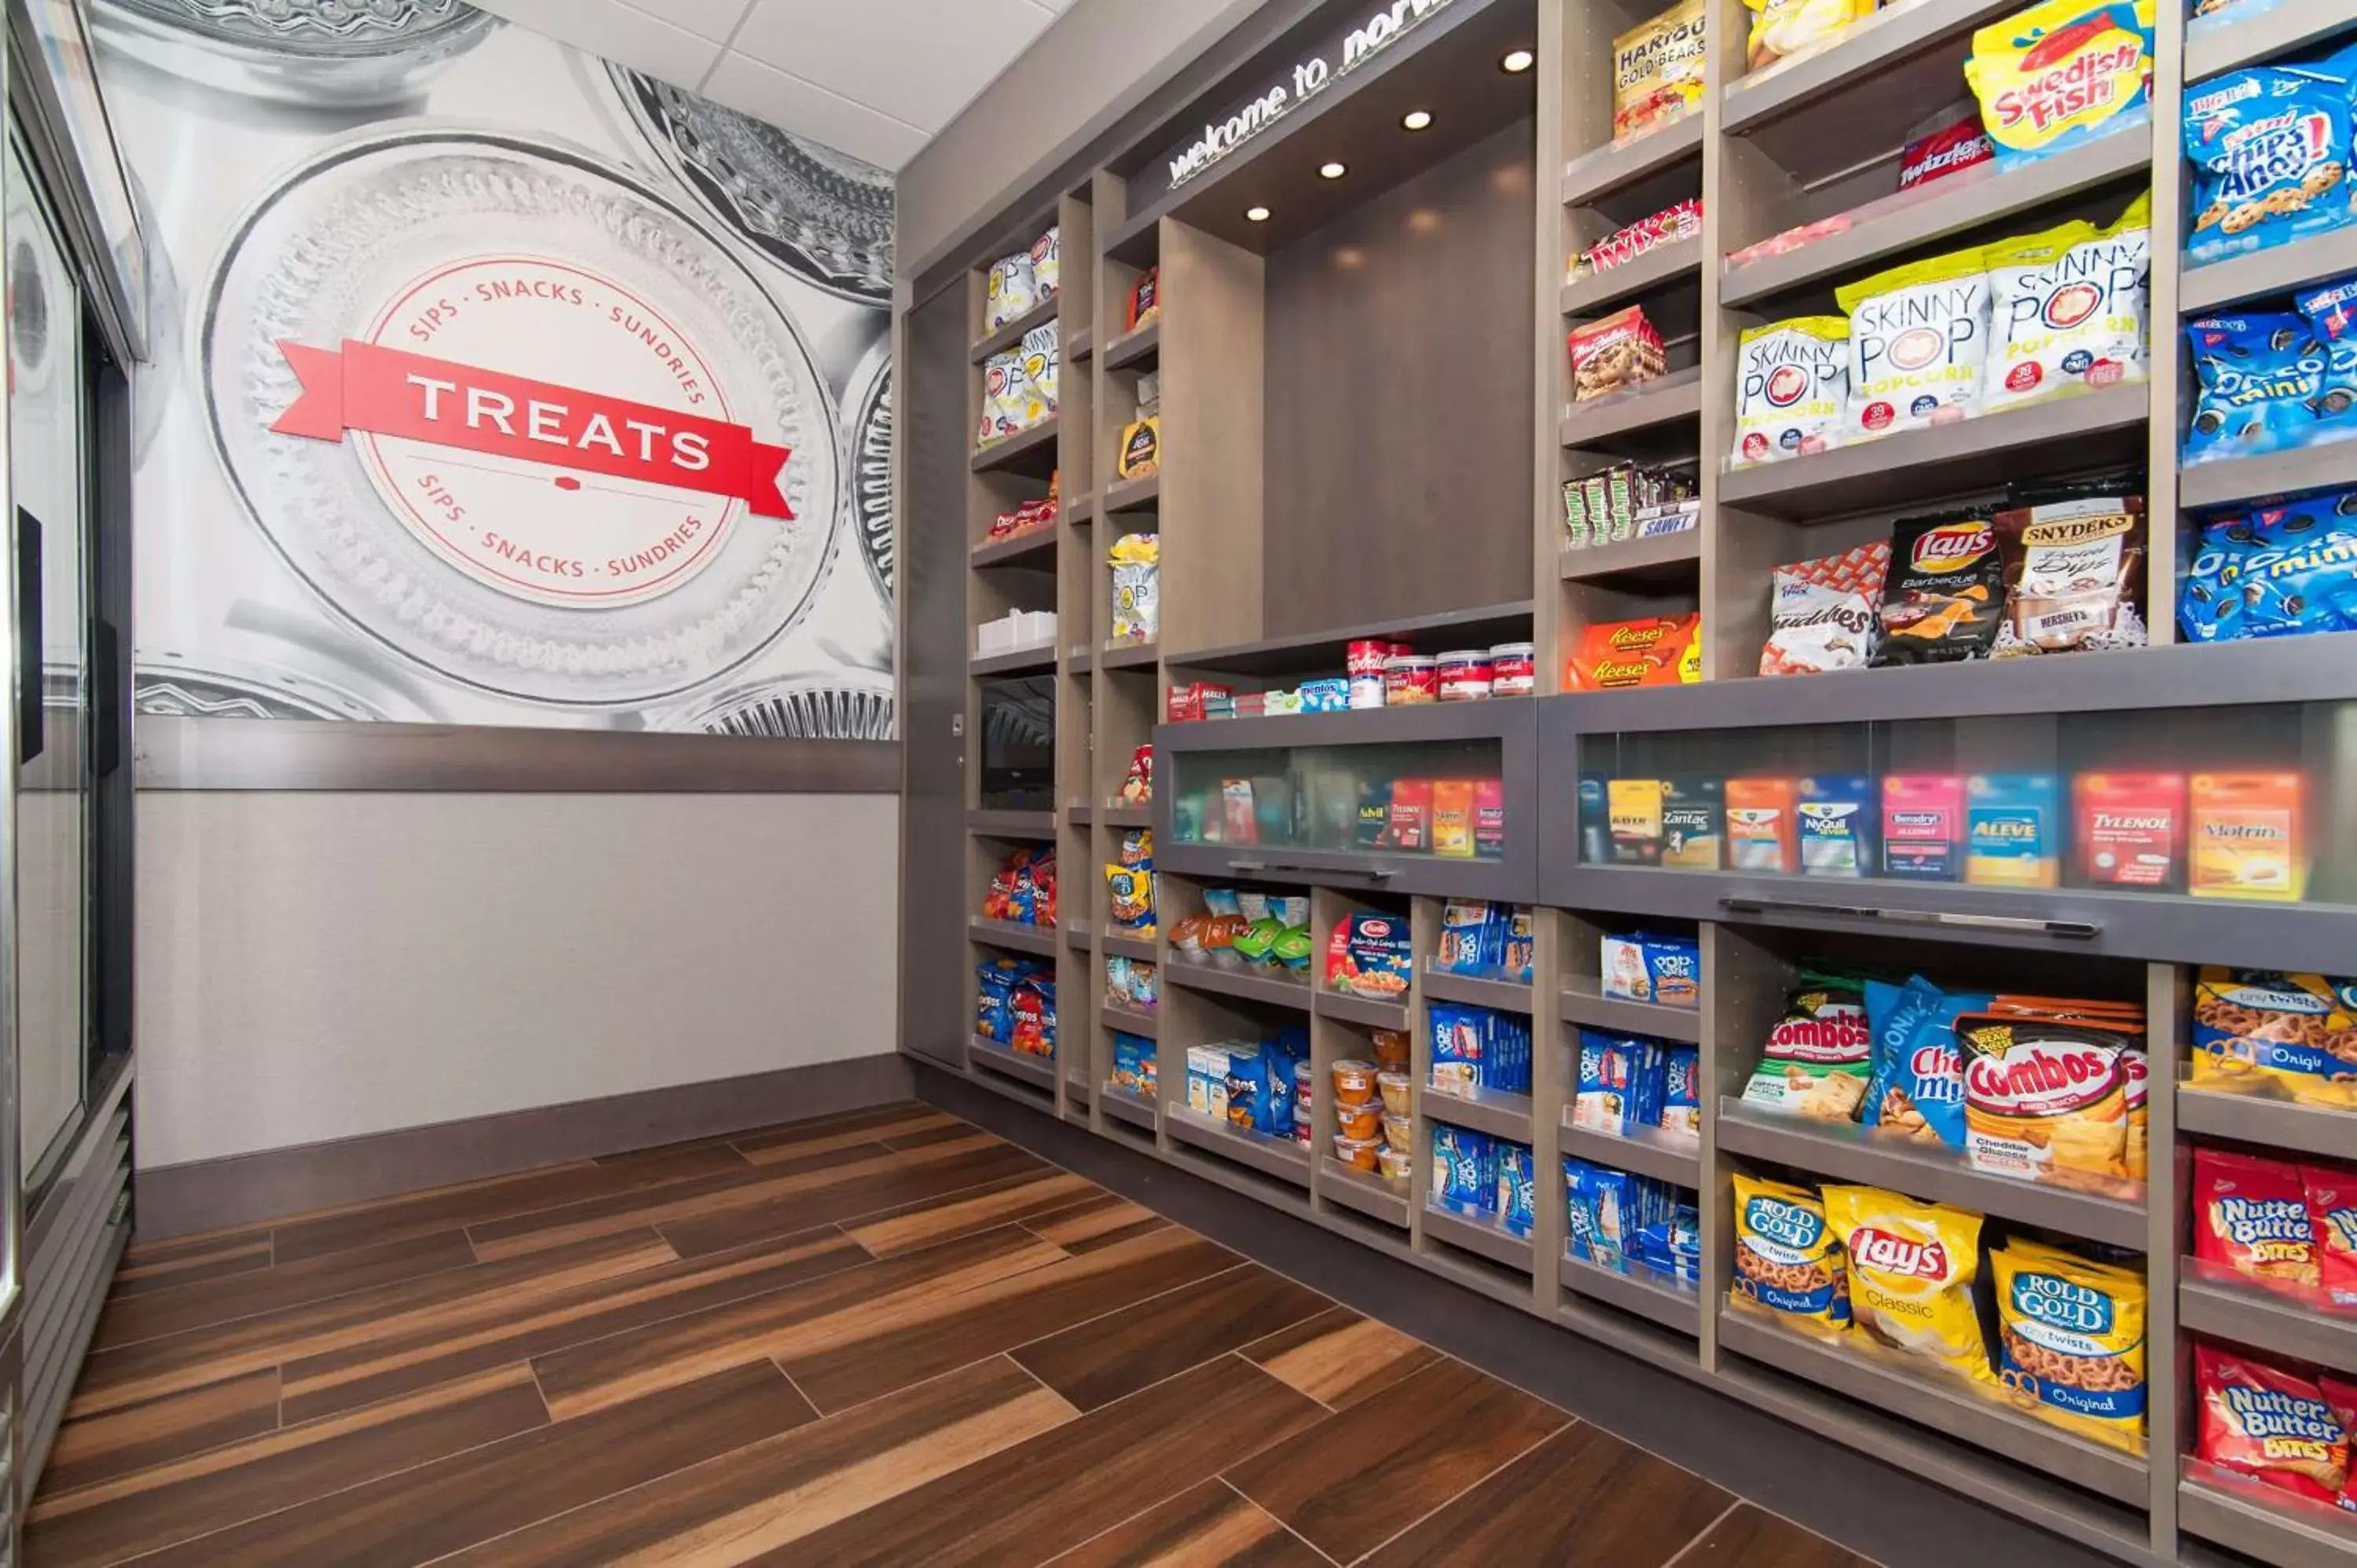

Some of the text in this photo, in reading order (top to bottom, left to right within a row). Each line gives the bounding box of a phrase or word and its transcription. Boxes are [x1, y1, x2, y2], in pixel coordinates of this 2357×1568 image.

[1995, 43, 2142, 127] Swedish
[1169, 86, 1288, 182] welcome
[1292, 57, 1329, 98] to
[2029, 79, 2115, 132] Fish
[1581, 214, 1671, 275] TWIX
[1860, 284, 1977, 336] SKINNY
[2008, 266, 2137, 343] POP
[409, 279, 705, 406] SIPS SNACKS SUNDRIES
[1746, 338, 1835, 374] SKINNY
[1860, 317, 1974, 383] POP
[1742, 363, 1838, 416] POP
[2229, 377, 2311, 406] mini
[405, 372, 711, 472] TREATS
[416, 473, 703, 578] SIPS SNACKS SUNDRIES
[1300, 684, 1336, 697] mentos
[1358, 807, 1384, 819] Advil
[1611, 815, 1647, 826] BAYER
[1662, 811, 1709, 825] Zantac
[1805, 818, 1846, 832] NyQuil
[1894, 813, 1937, 826] Benadryl
[2092, 814, 2169, 830] TYLENOL
[1973, 821, 2037, 837] ALEVE
[2205, 823, 2276, 840] Motrin
[2268, 994, 2319, 1009] twists
[1970, 1047, 2106, 1097] Combos
[1915, 1077, 1966, 1103] mi
[1760, 1198, 1814, 1228] ROLD
[1750, 1212, 1814, 1247] GOLD
[1767, 1290, 1813, 1310] Original
[1866, 1289, 1934, 1320] Classic
[2029, 1274, 2099, 1306] ROLD
[2018, 1291, 2103, 1331] GOLD
[2053, 1388, 2117, 1412] Original
[2227, 1387, 2325, 1422] Nutter
[2243, 1412, 2340, 1442] Butter
